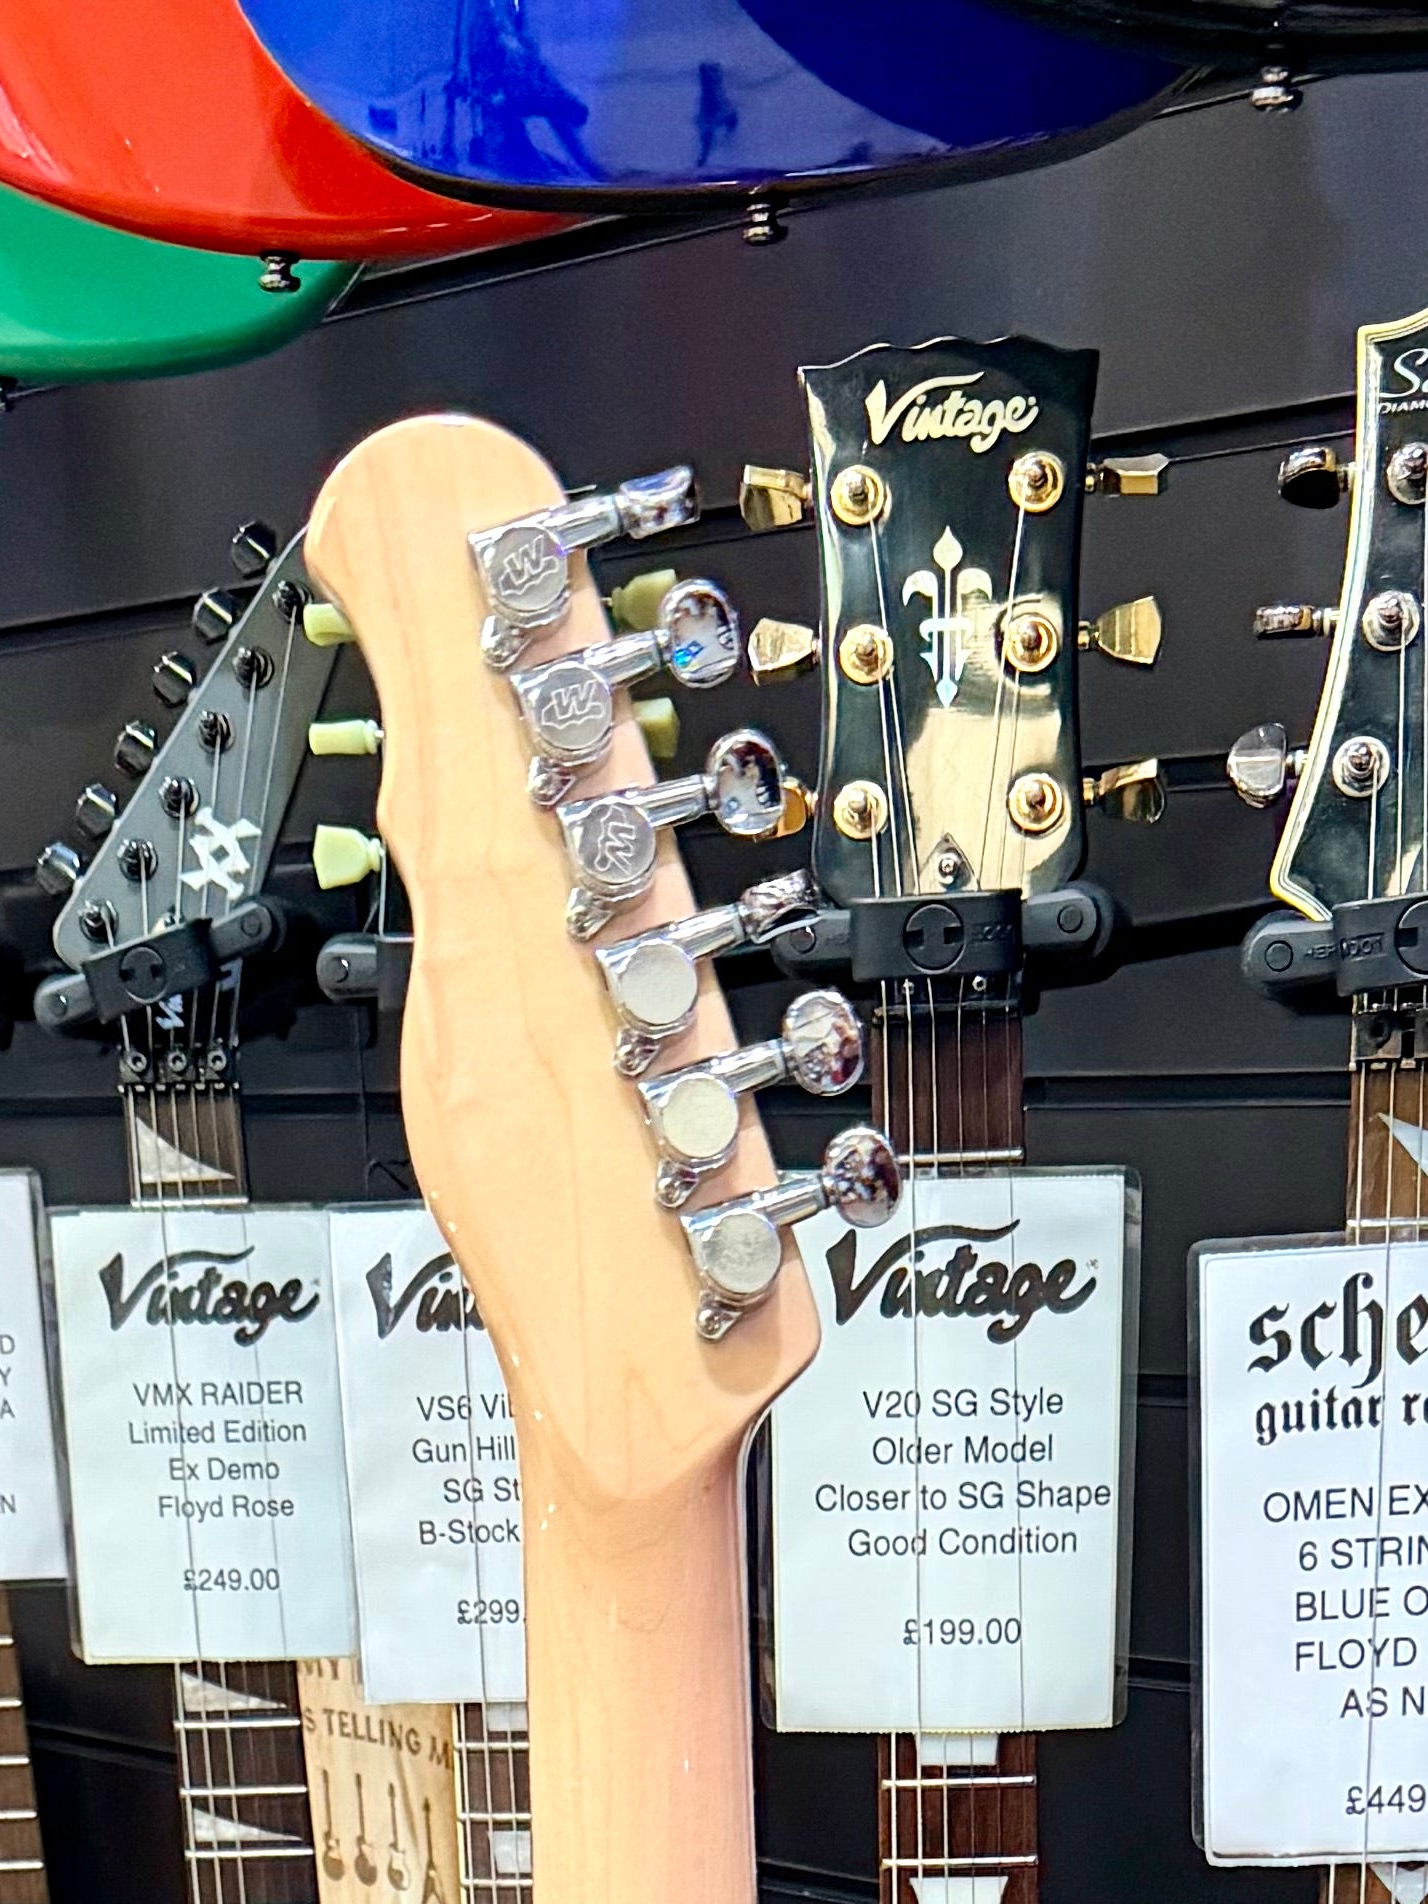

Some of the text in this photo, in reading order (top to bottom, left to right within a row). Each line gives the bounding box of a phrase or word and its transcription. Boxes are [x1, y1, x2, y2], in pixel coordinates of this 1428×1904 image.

[865, 372, 1039, 453] Vintage
[99, 1245, 321, 1347] Vintage
[826, 1218, 1097, 1345] Vintage
[133, 1381, 304, 1408] VMX RAIDER
[416, 1396, 472, 1422] VS6
[862, 1387, 1064, 1422] V20 SG Style
[1256, 1385, 1386, 1446] guitar
[128, 1418, 307, 1445] Limited Edition
[412, 1438, 468, 1464] Gun
[872, 1435, 1053, 1466] Older Model
[169, 1457, 280, 1482] Ex Demo
[443, 1478, 484, 1503] SG
[815, 1480, 1112, 1514] Closer to SG Shape
[1263, 1486, 1374, 1524] OMEN
[158, 1494, 295, 1523] Floyd Rose
[419, 1518, 521, 1546] B-Stock
[848, 1527, 1077, 1557] Good Condition
[1298, 1541, 1317, 1572] 6
[183, 1566, 281, 1592] £249.00
[1295, 1587, 1392, 1622] BLUE
[902, 1617, 1023, 1645] £199.00
[1295, 1637, 1417, 1672] FLOYD
[1340, 1687, 1389, 1719] AS
[322, 1707, 422, 1757] TELLING
